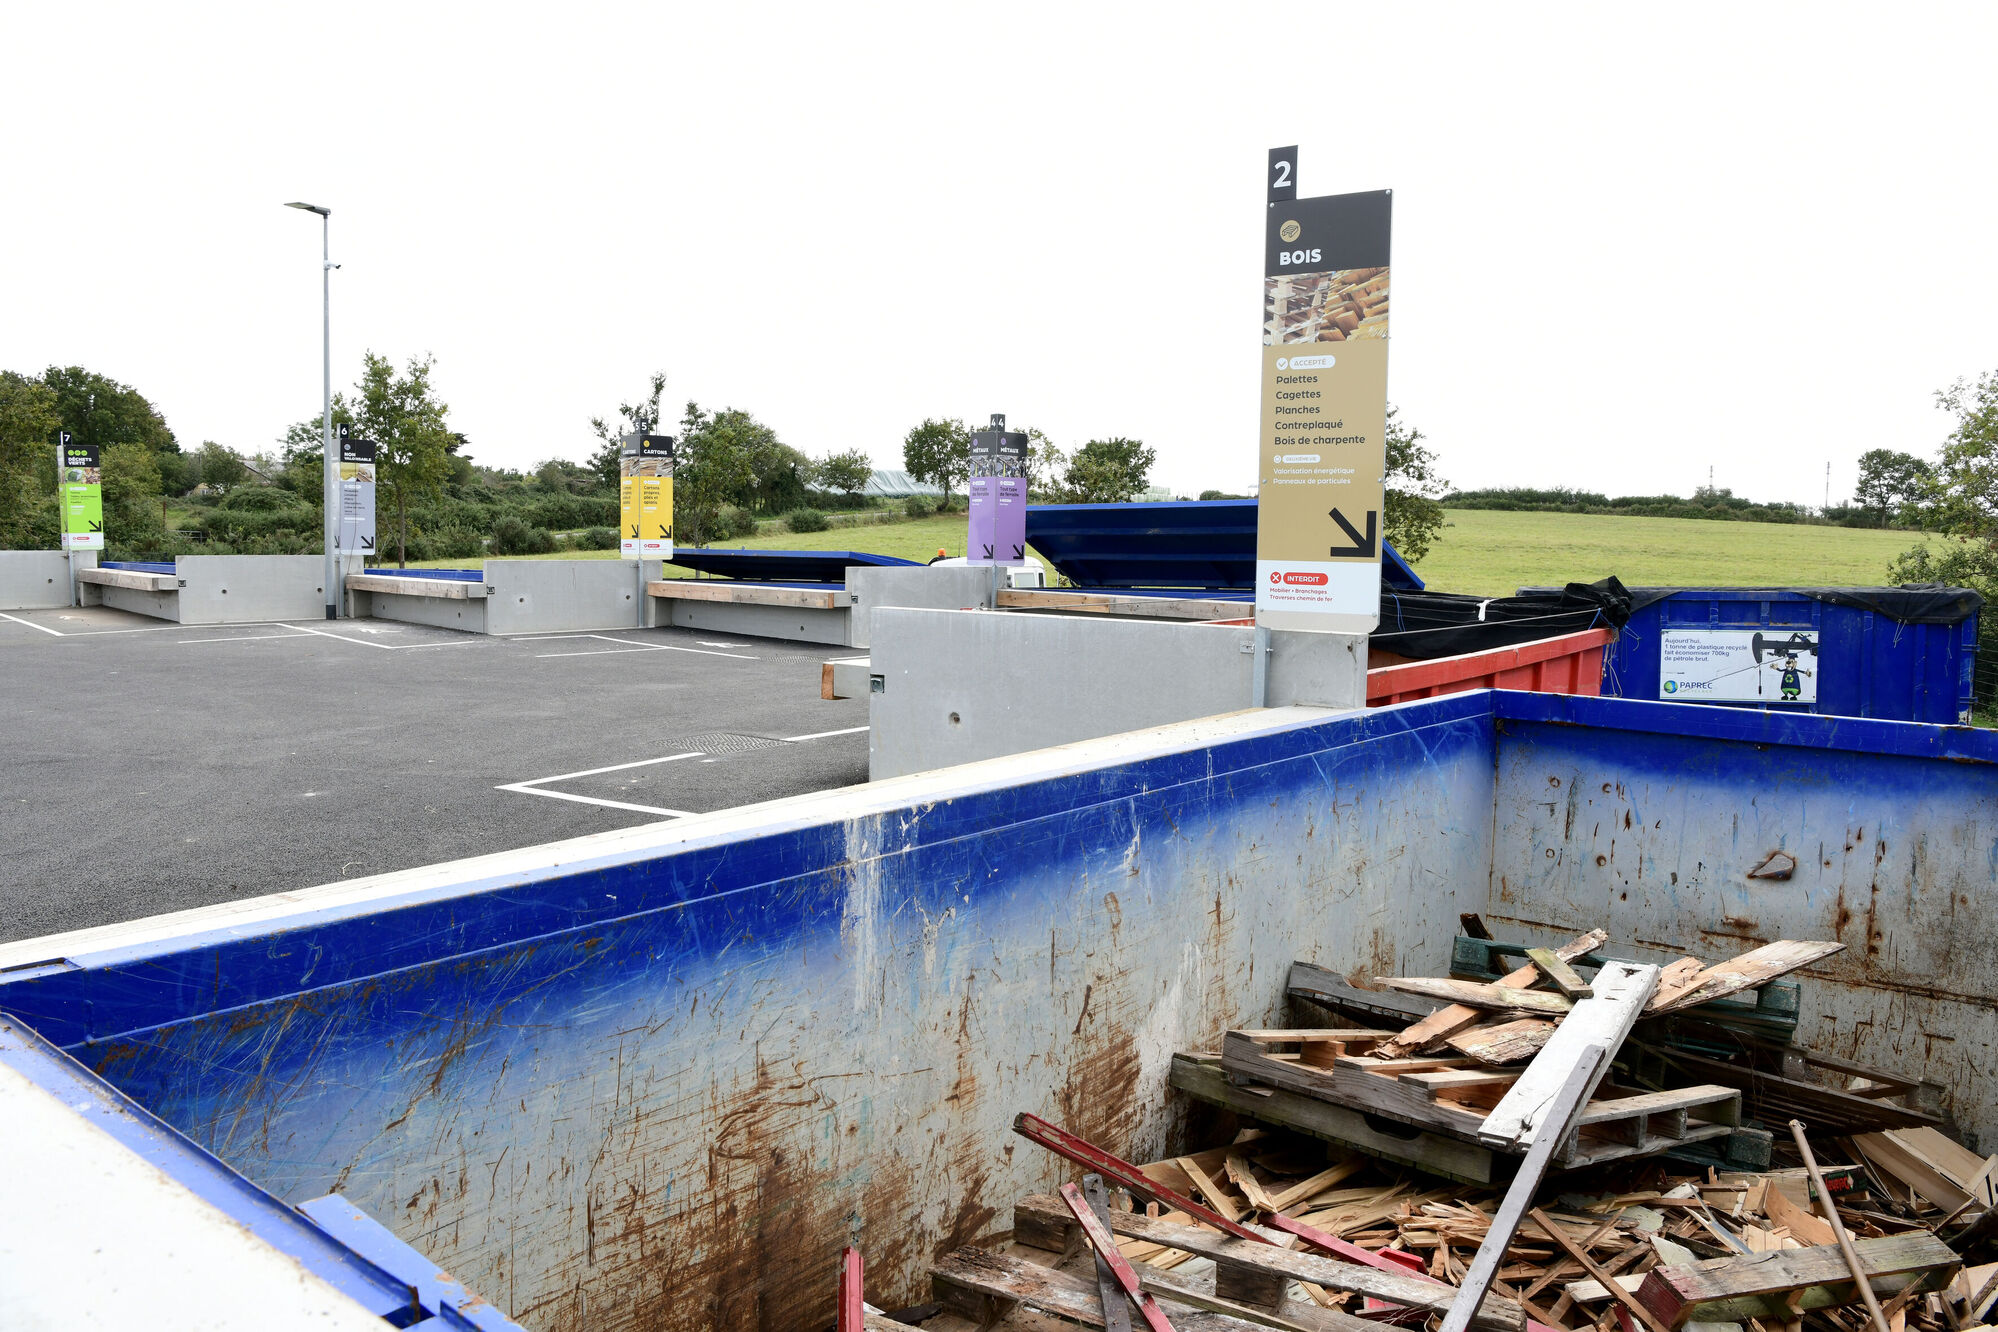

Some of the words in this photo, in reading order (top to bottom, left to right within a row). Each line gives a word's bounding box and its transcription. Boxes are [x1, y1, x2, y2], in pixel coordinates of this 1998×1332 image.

[1273, 160, 1292, 189] 2
[1279, 248, 1322, 266] BOIS
[1293, 358, 1327, 367] ACCEPTÉ
[1276, 375, 1318, 385] Palettes
[1275, 390, 1321, 401] Cagettes
[1275, 405, 1320, 415] Planches
[641, 422, 647, 430] 5
[998, 418, 1004, 427] 4
[1275, 419, 1344, 431] Contreplaqué
[341, 427, 348, 435] 6
[64, 434, 71, 442] 7
[1274, 435, 1296, 445] Bois
[1298, 436, 1311, 445] de
[1313, 435, 1366, 446] charpente
[1287, 575, 1320, 583] INTERDIT
[1680, 681, 1713, 689] PAPREC
